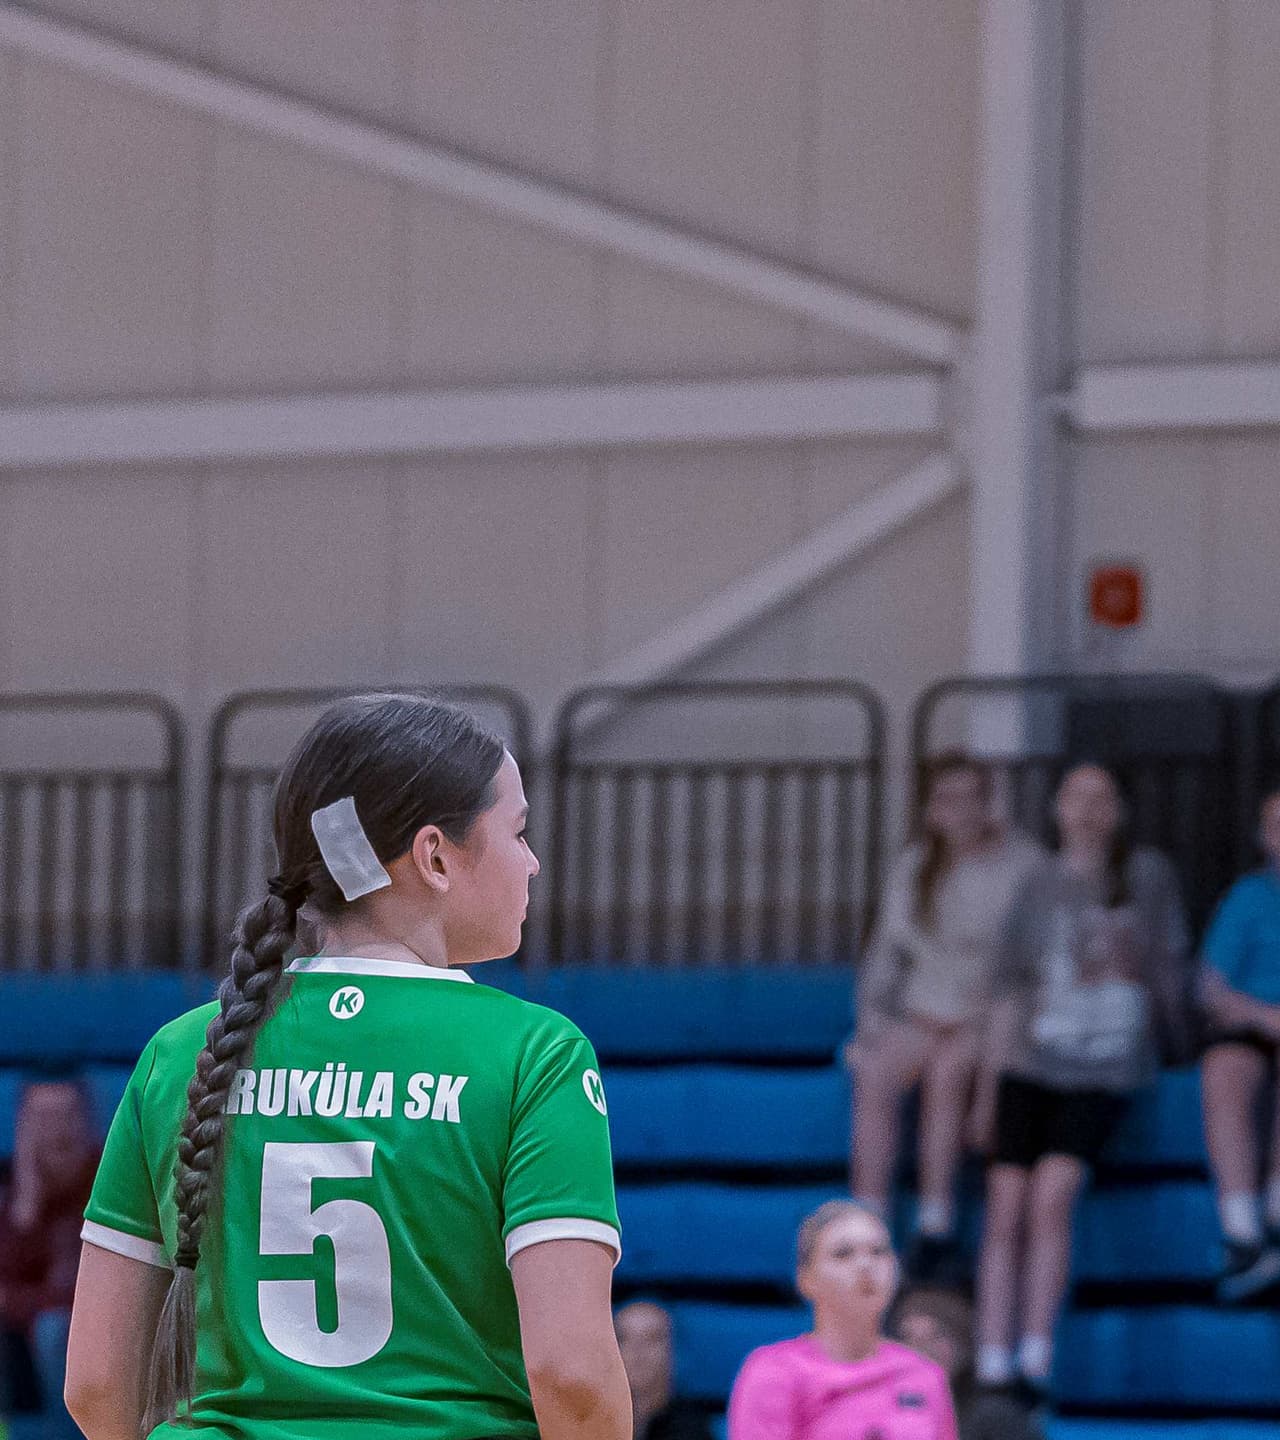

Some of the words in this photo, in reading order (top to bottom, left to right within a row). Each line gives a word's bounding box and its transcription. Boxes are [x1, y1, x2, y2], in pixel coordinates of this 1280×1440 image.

[222, 1062, 395, 1118] RUKÜLA
[403, 1071, 469, 1124] SK
[257, 1141, 394, 1367] 5
